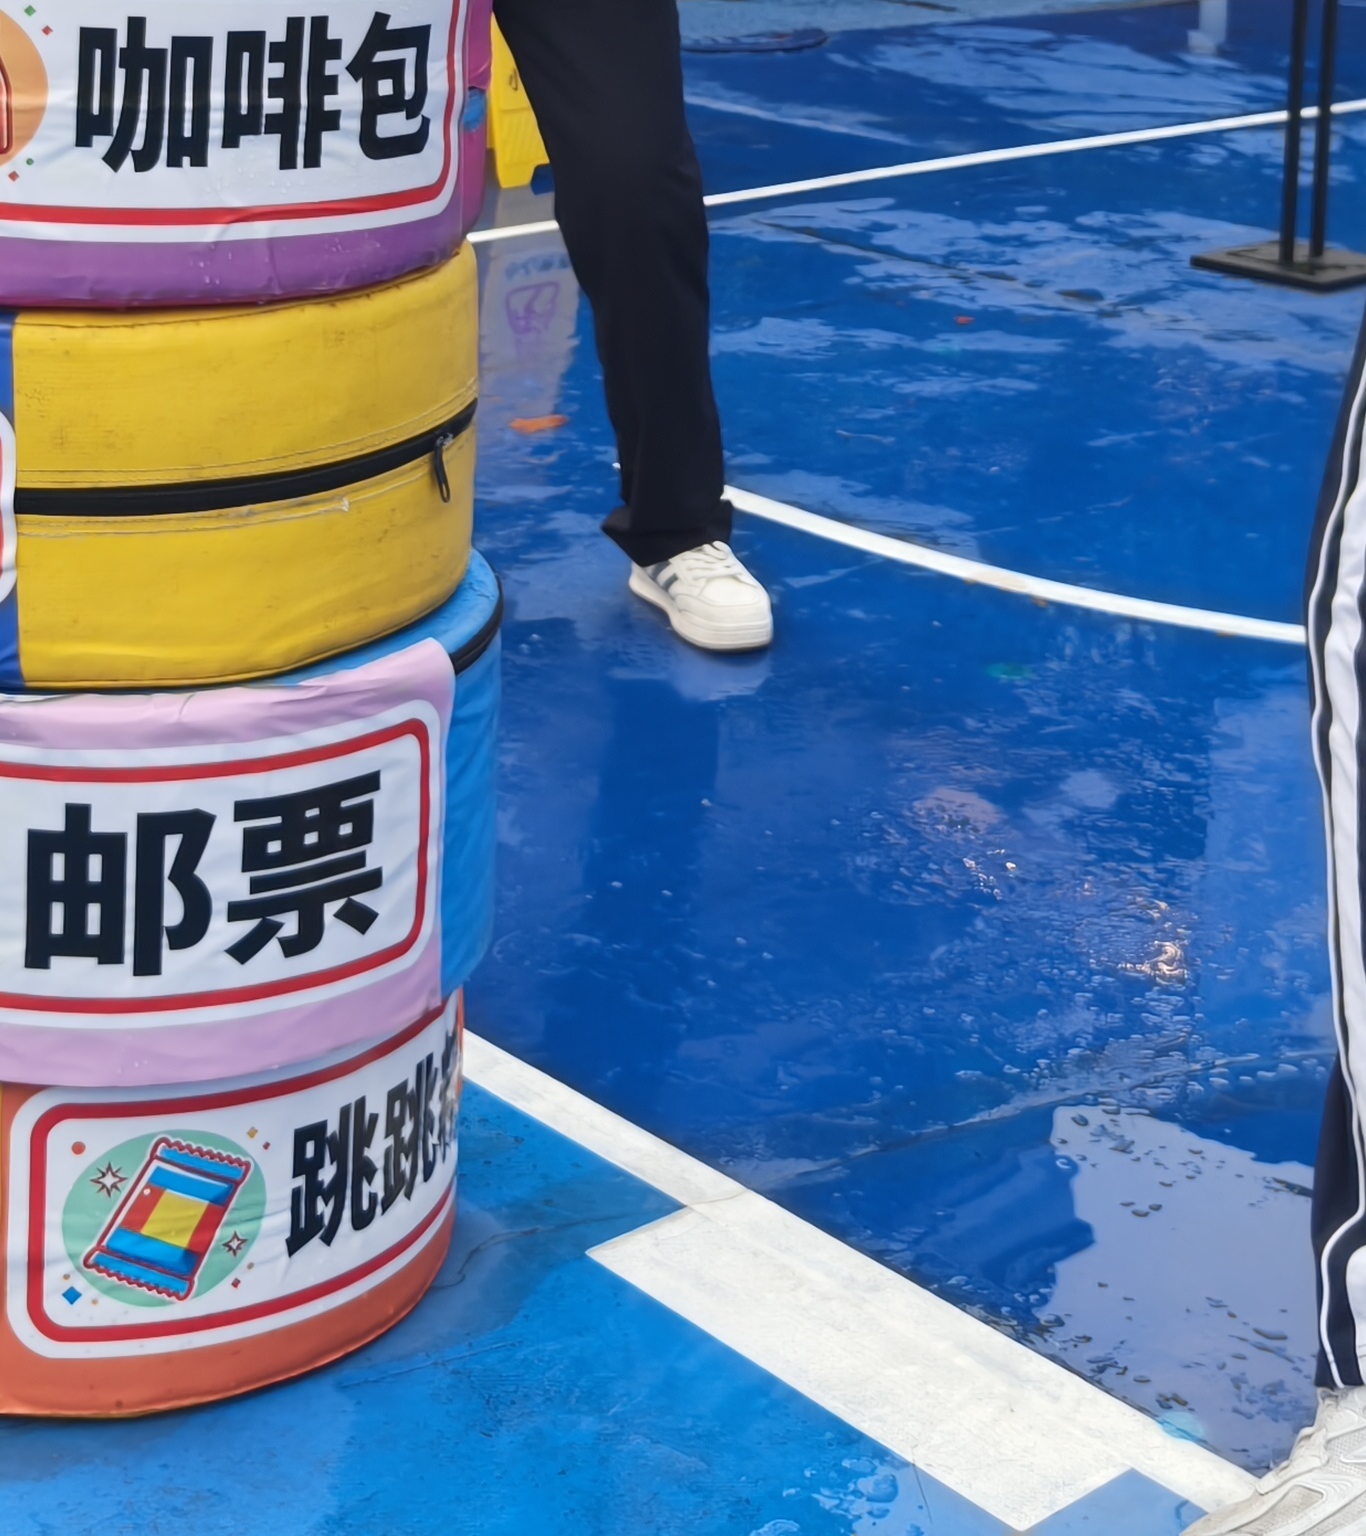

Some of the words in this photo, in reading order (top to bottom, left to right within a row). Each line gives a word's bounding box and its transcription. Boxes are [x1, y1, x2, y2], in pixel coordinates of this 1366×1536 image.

[75, 11, 432, 173] 咖啡包
[24, 769, 383, 976] 邮票
